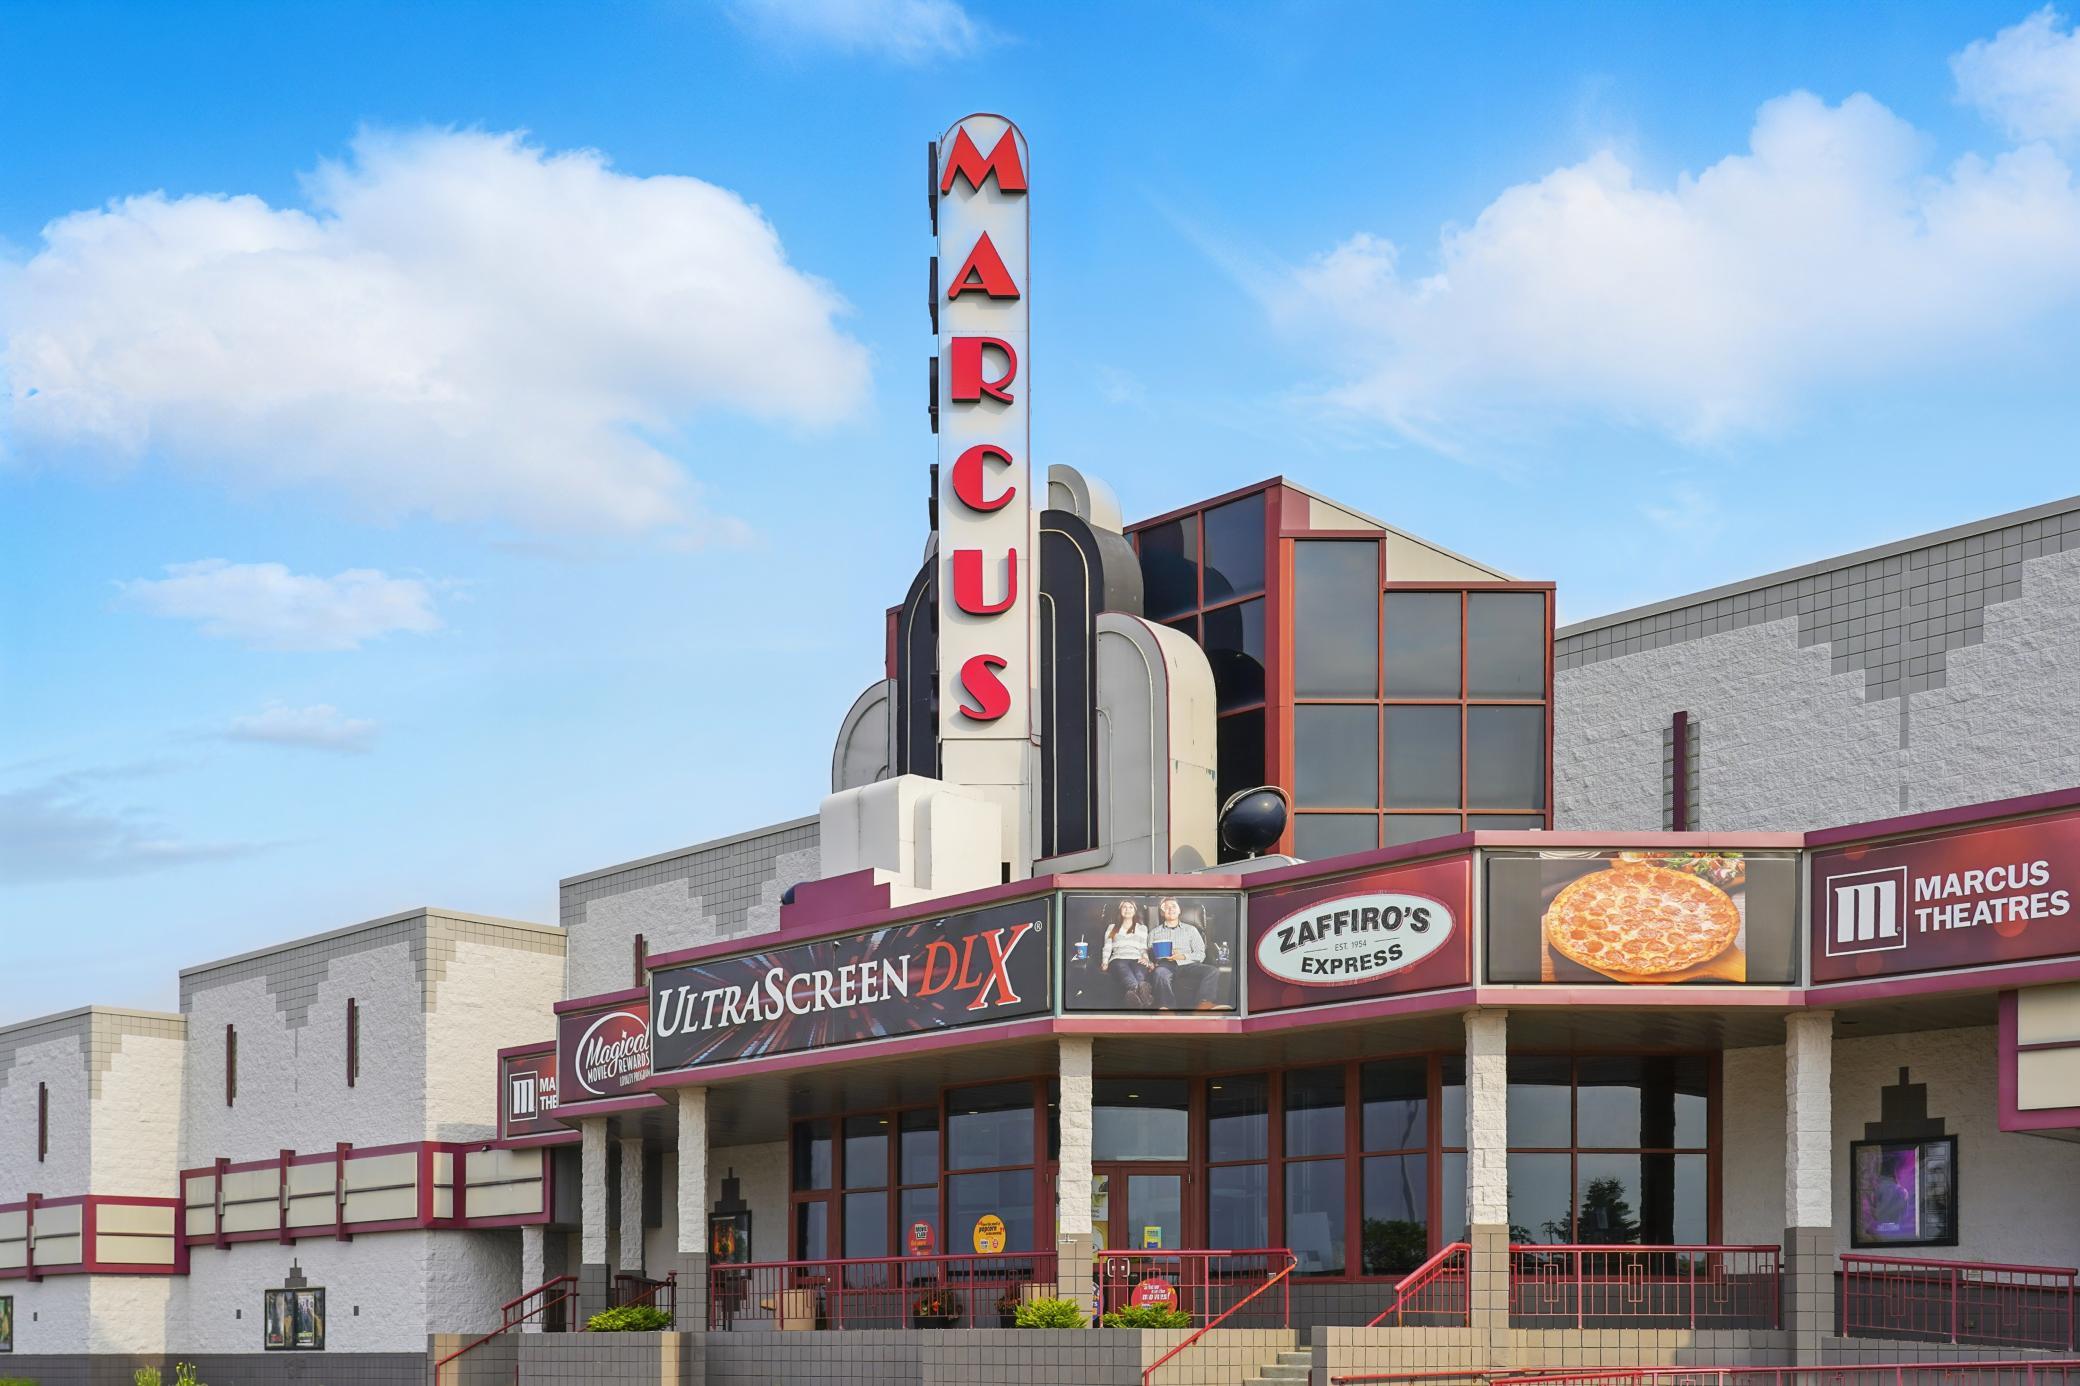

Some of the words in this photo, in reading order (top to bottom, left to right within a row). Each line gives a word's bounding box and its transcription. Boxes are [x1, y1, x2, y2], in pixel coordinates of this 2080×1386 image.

[941, 125, 1027, 722] MARCUS
[1914, 860, 2050, 902] MARCUS
[1277, 905, 1432, 954] ZAFFIRO'S
[1914, 890, 2071, 933] THEATRES
[1301, 943, 1403, 975] EXPRESS
[1334, 943, 1348, 951] EST.
[1351, 939, 1367, 948] 1954
[586, 1021, 650, 1077] Magical
[587, 1065, 607, 1084] MOVIE
[618, 1051, 650, 1074] REWARDS
